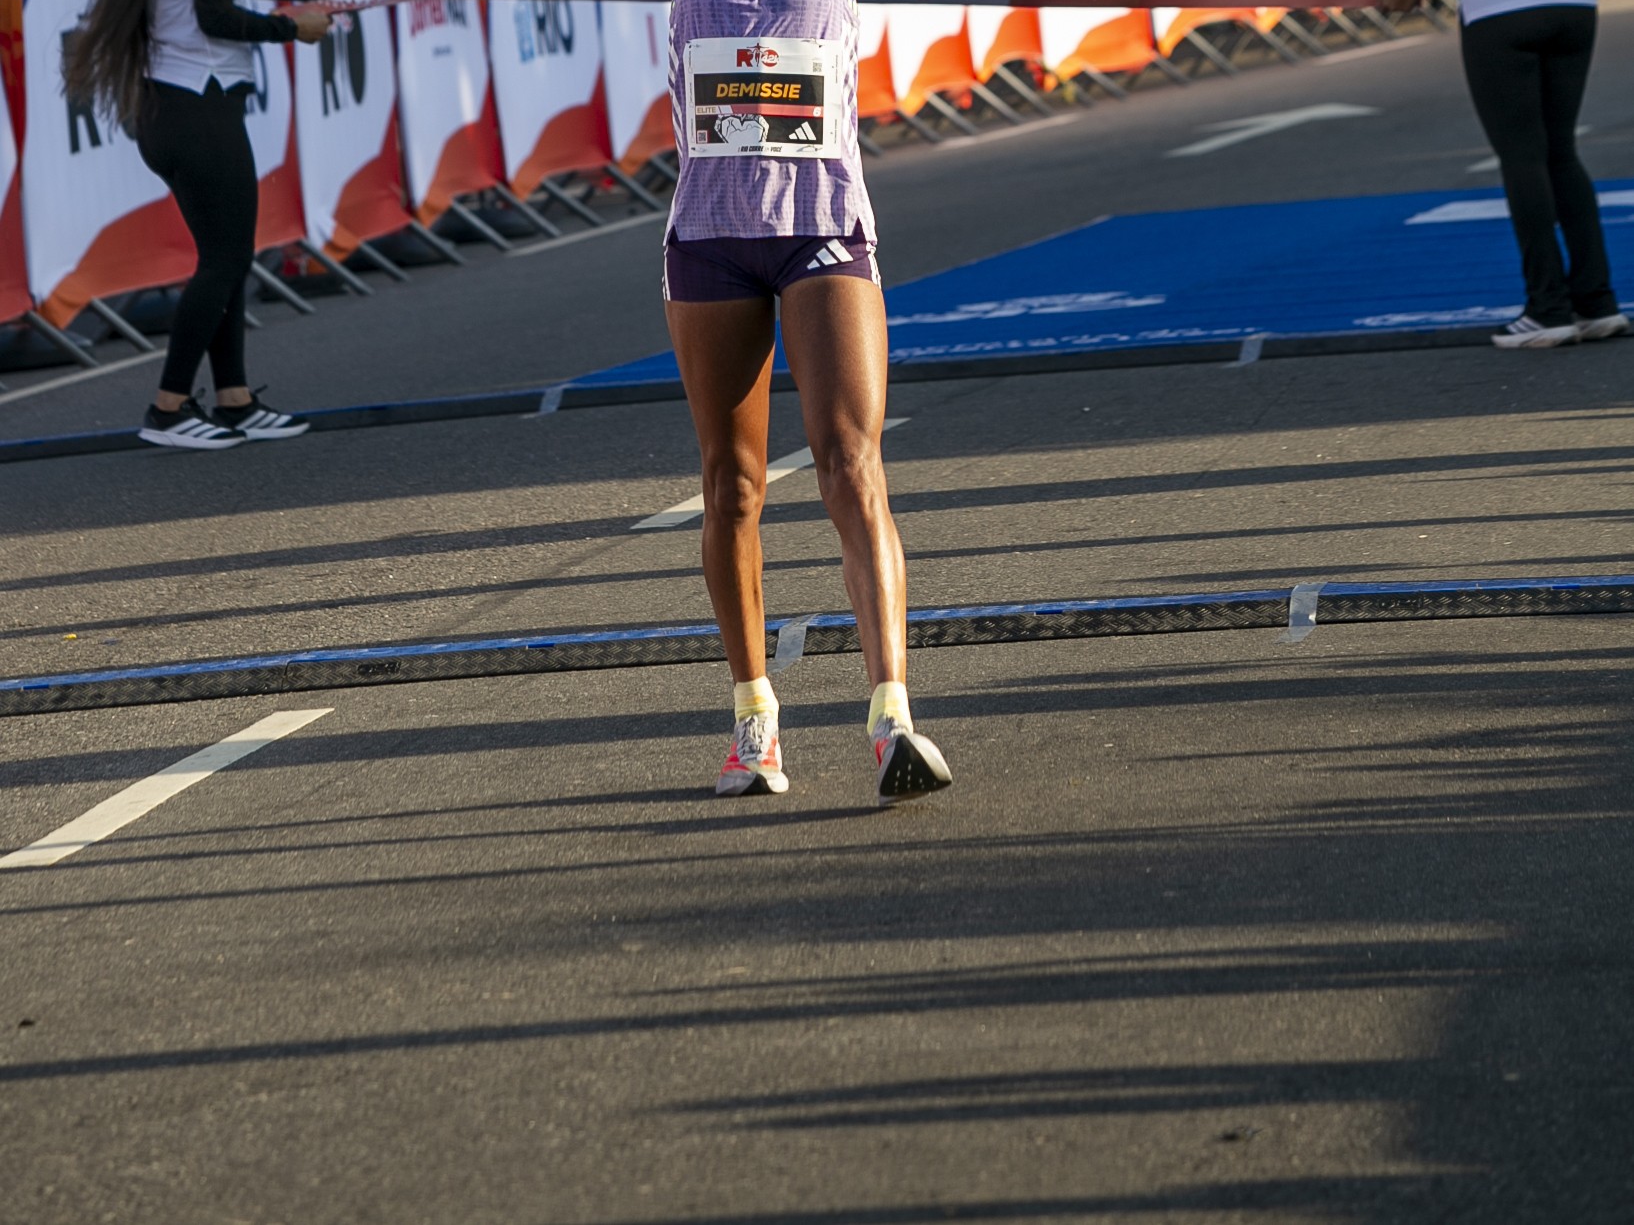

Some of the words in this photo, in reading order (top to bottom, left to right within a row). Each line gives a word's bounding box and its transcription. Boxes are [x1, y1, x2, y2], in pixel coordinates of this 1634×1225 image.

[716, 82, 801, 99] DEMISSIE
[696, 106, 717, 114] ELITE
[813, 107, 822, 117] 6
